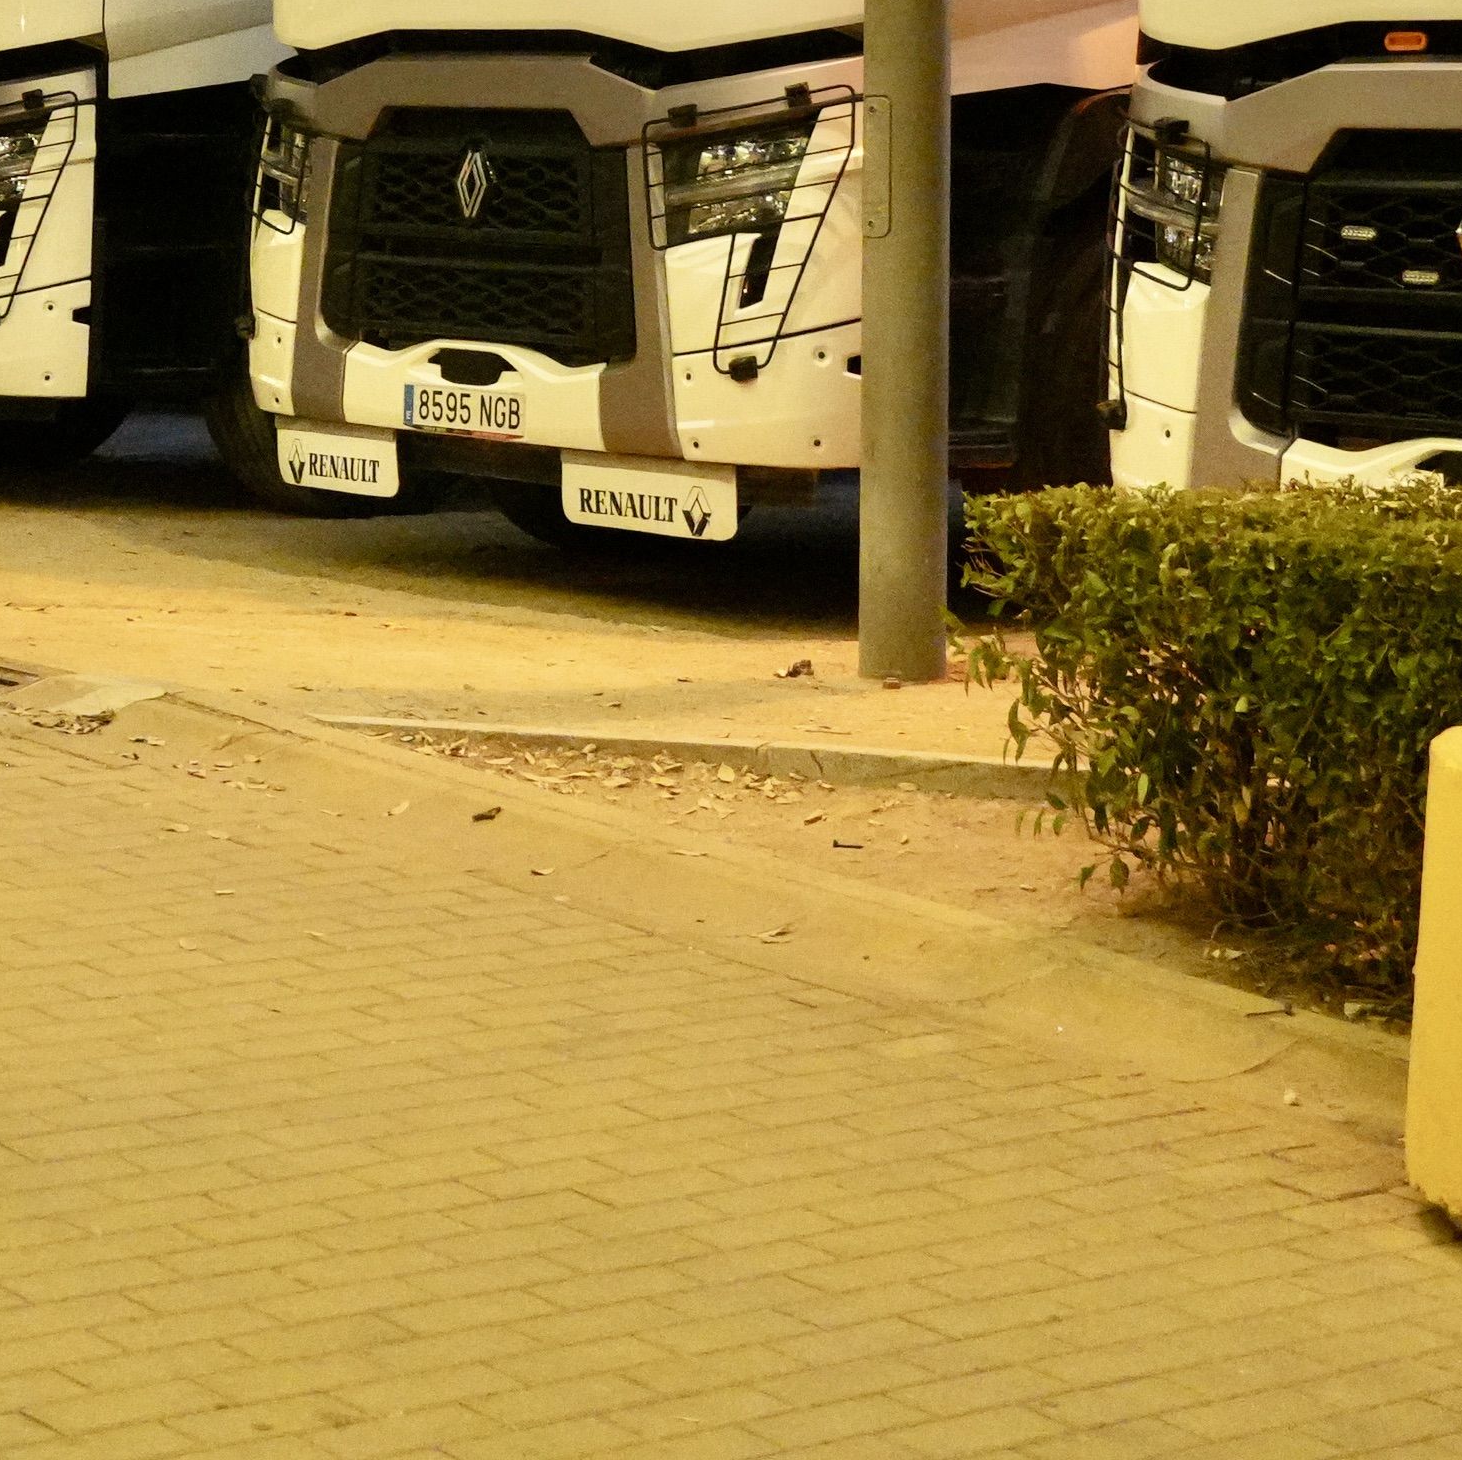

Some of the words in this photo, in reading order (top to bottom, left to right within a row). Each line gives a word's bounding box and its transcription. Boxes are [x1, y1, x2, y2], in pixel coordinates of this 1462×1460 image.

[419, 390, 472, 425] 8595
[479, 395, 521, 431] NGB
[308, 452, 380, 484] RENAULT
[578, 487, 678, 524] RENAULT
